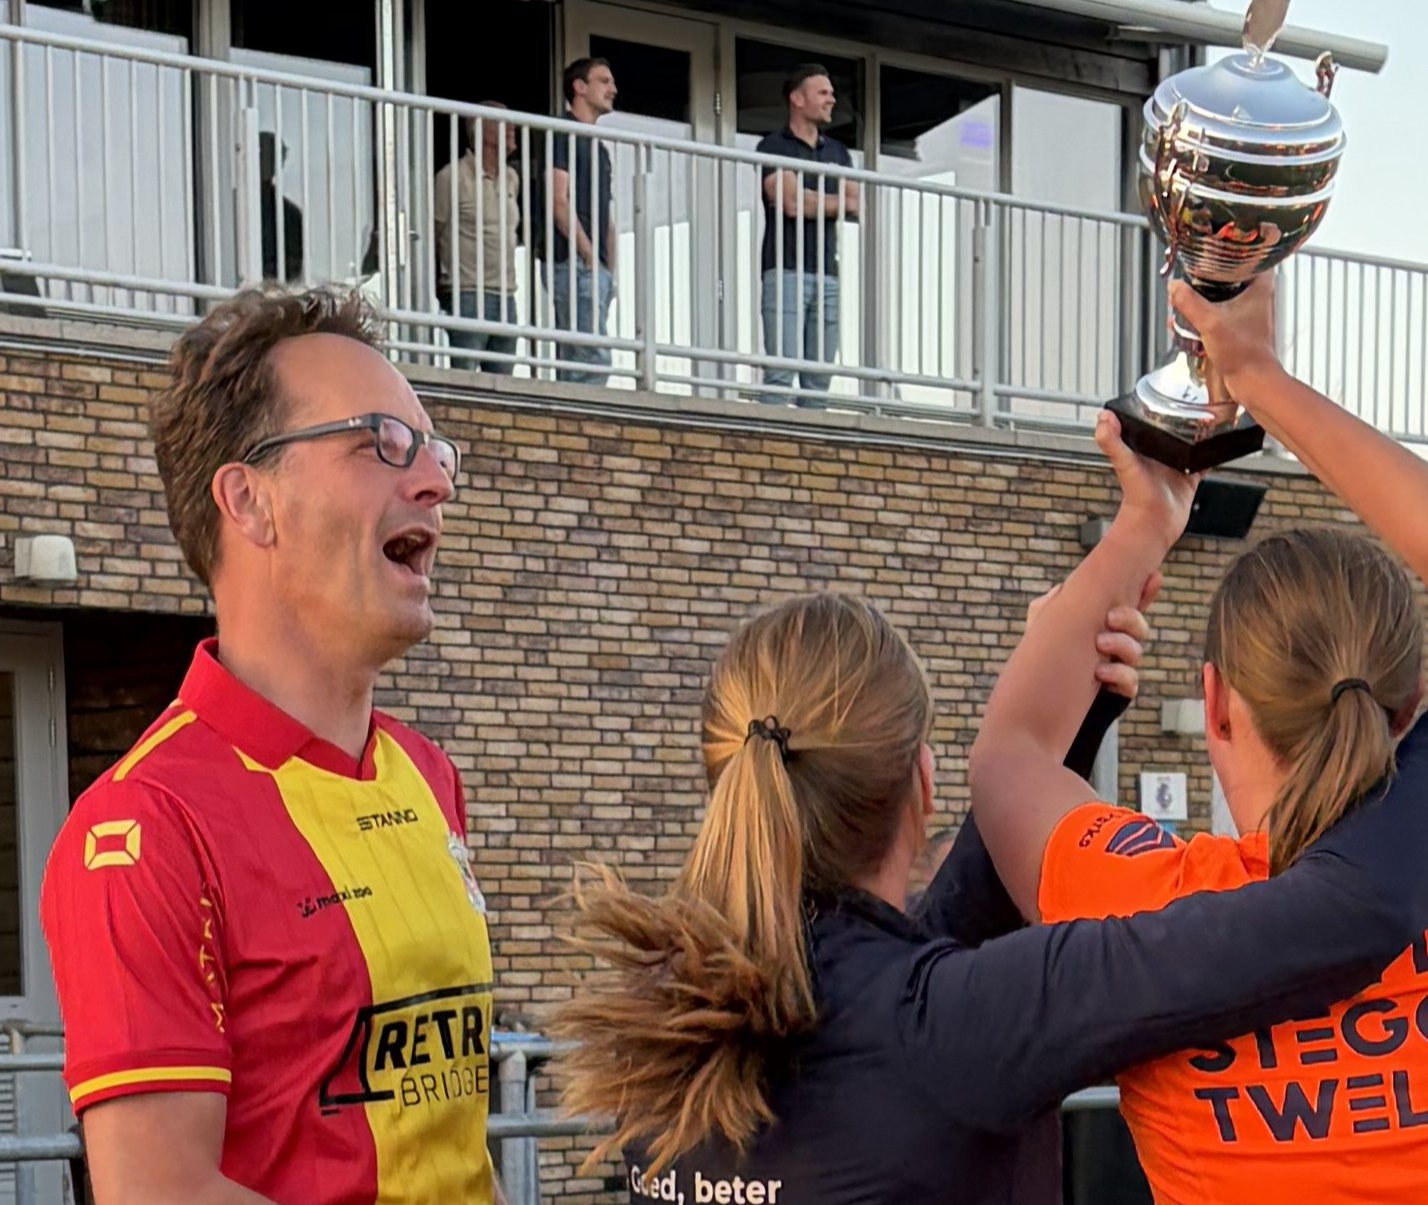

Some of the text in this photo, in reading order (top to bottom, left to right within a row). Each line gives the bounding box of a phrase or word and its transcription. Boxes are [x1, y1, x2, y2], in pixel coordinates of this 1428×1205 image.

[356, 808, 419, 832] STANNO
[374, 1002, 491, 1072] RETR
[401, 1064, 489, 1107] BRIDGE
[694, 1171, 783, 1205] beter
